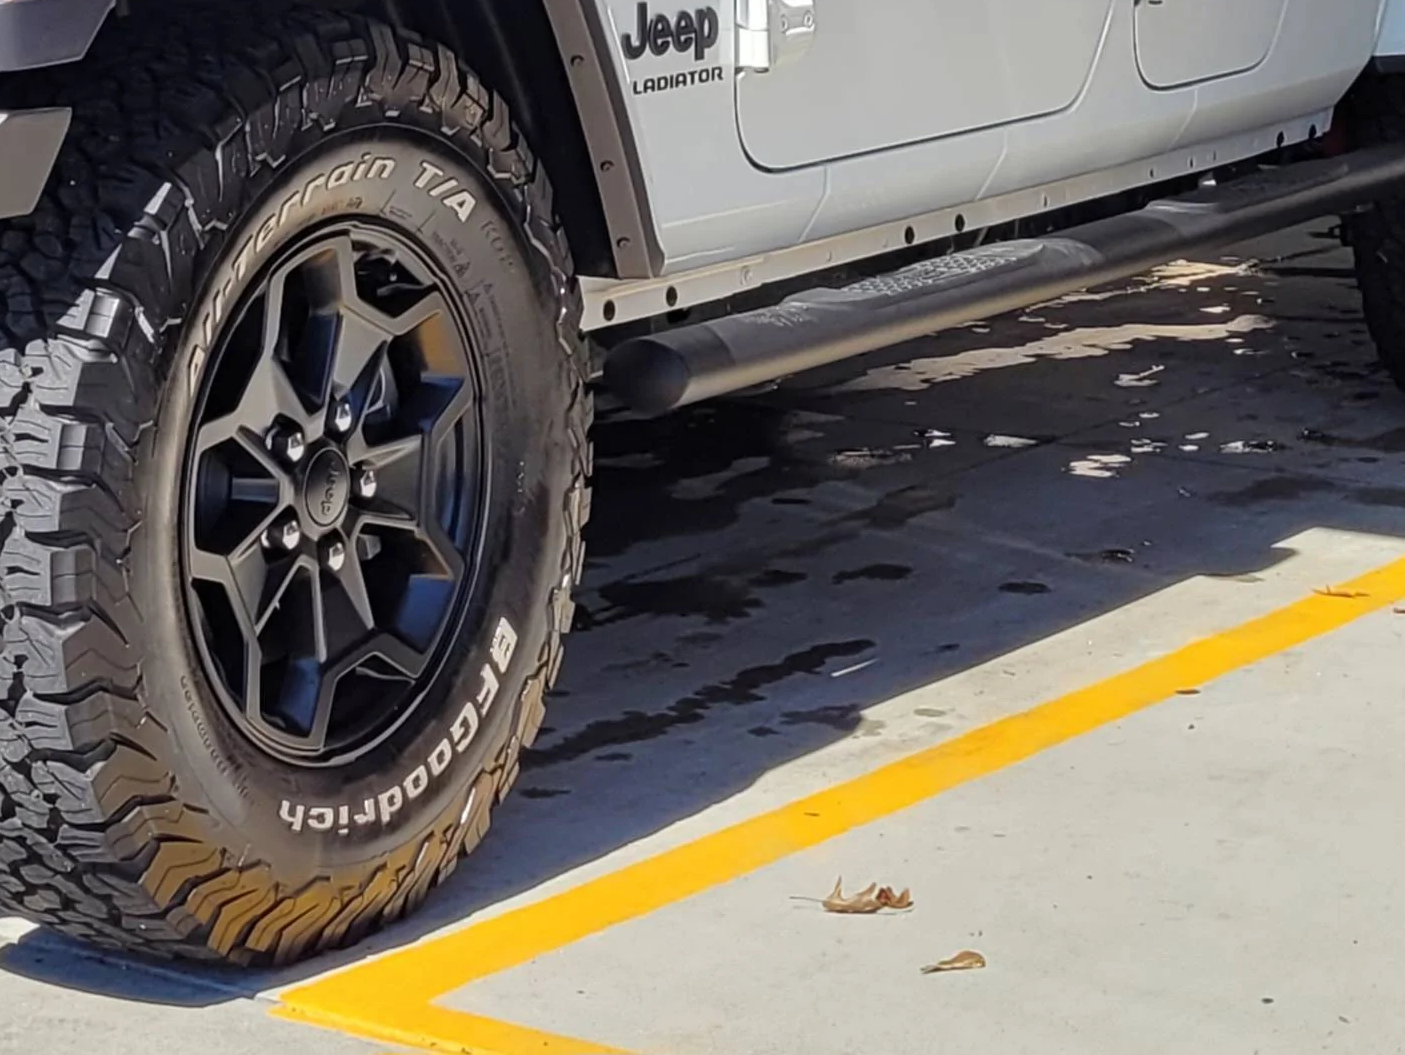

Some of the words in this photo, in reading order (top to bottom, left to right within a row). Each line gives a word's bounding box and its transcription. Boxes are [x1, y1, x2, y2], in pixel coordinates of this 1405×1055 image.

[621, 1, 719, 62] Jeep
[632, 66, 724, 95] LADIATOR
[413, 159, 477, 223] T/A
[279, 616, 518, 836] BFGoodrich
